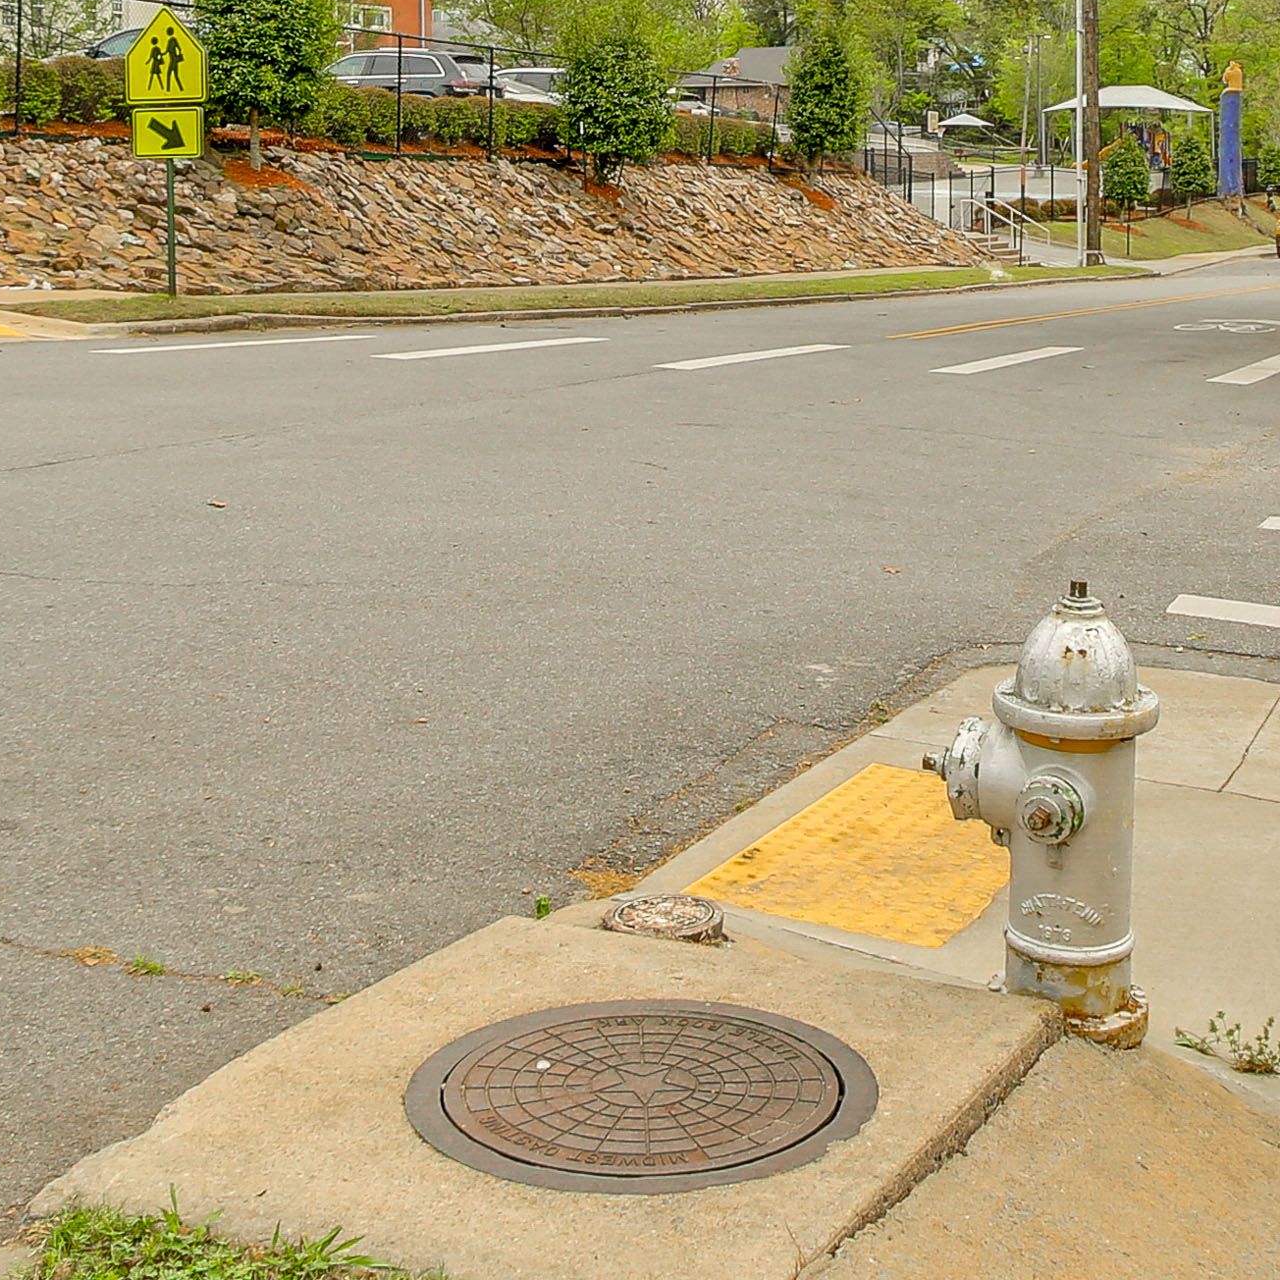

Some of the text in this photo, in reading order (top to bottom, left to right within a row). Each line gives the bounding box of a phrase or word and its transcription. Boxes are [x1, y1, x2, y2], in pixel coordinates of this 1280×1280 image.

[659, 1017, 724, 1032] ROCK
[728, 1027, 801, 1061] LITTLE
[478, 1116, 688, 1167] MIDWEST CASTING
